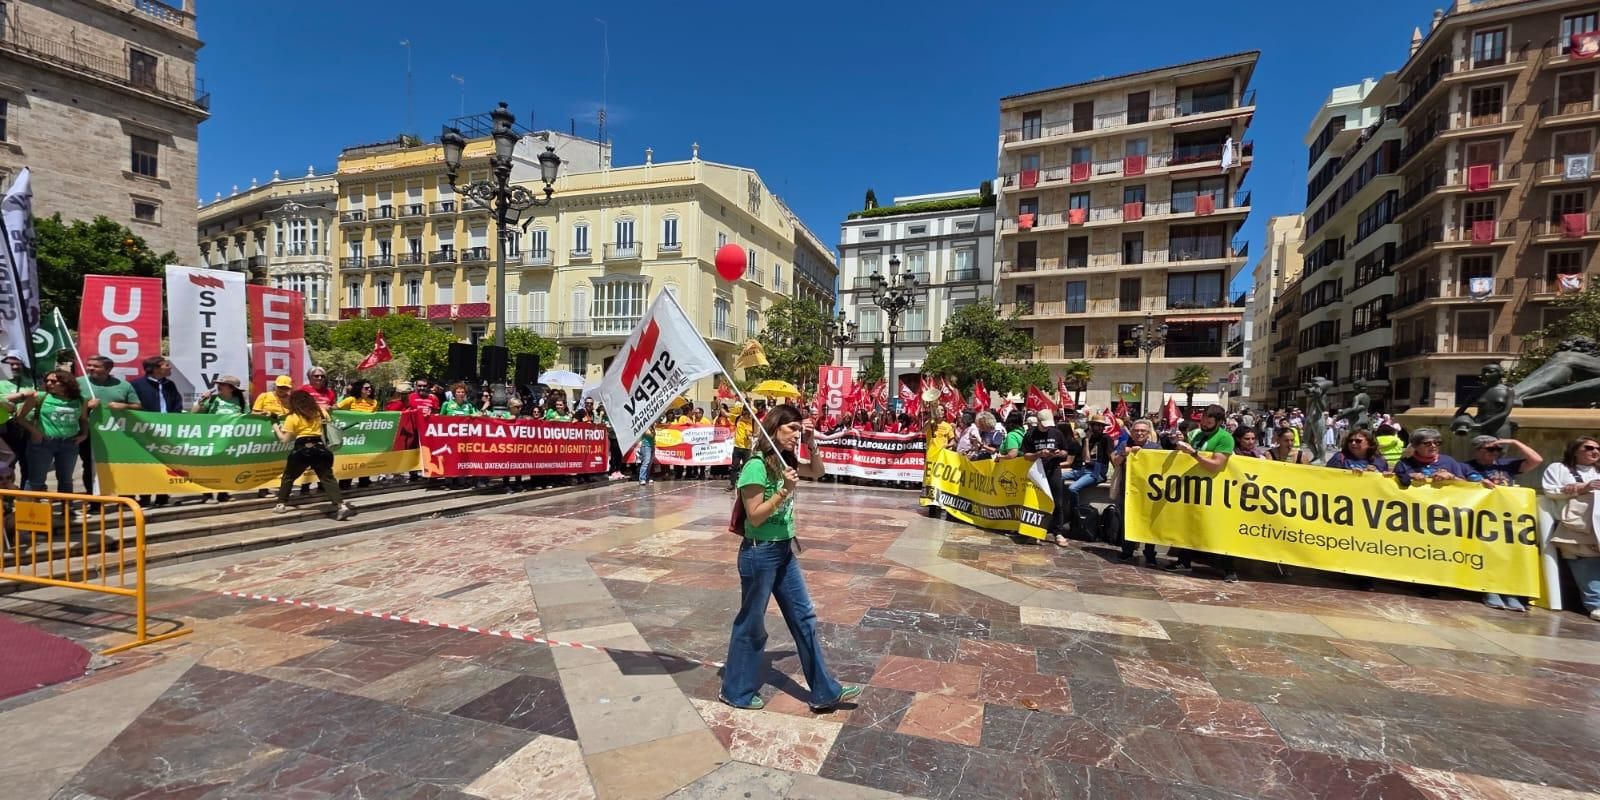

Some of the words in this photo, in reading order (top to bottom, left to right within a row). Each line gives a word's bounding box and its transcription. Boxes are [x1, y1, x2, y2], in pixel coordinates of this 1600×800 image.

[199, 290, 220, 391] STEPV
[98, 416, 127, 432] JA
[132, 422, 173, 438] N'HI
[177, 424, 203, 439] HA
[207, 423, 263, 439] PROU!
[424, 423, 482, 438] ALCEM
[485, 424, 507, 438] LA
[508, 426, 536, 439] VEU
[537, 427, 542, 439] I
[543, 427, 584, 440] DIGUEM
[145, 442, 215, 457] +salari
[457, 441, 553, 454] RECLASSIFICACIÓ
[554, 443, 558, 454] I
[858, 440, 896, 451] LABORALS
[853, 454, 887, 465] MILLORS
[888, 457, 925, 466] SALARIS
[926, 461, 966, 487] ECOLA
[1146, 473, 1213, 506] som
[1238, 522, 1484, 571] activistespelvalencia.org
